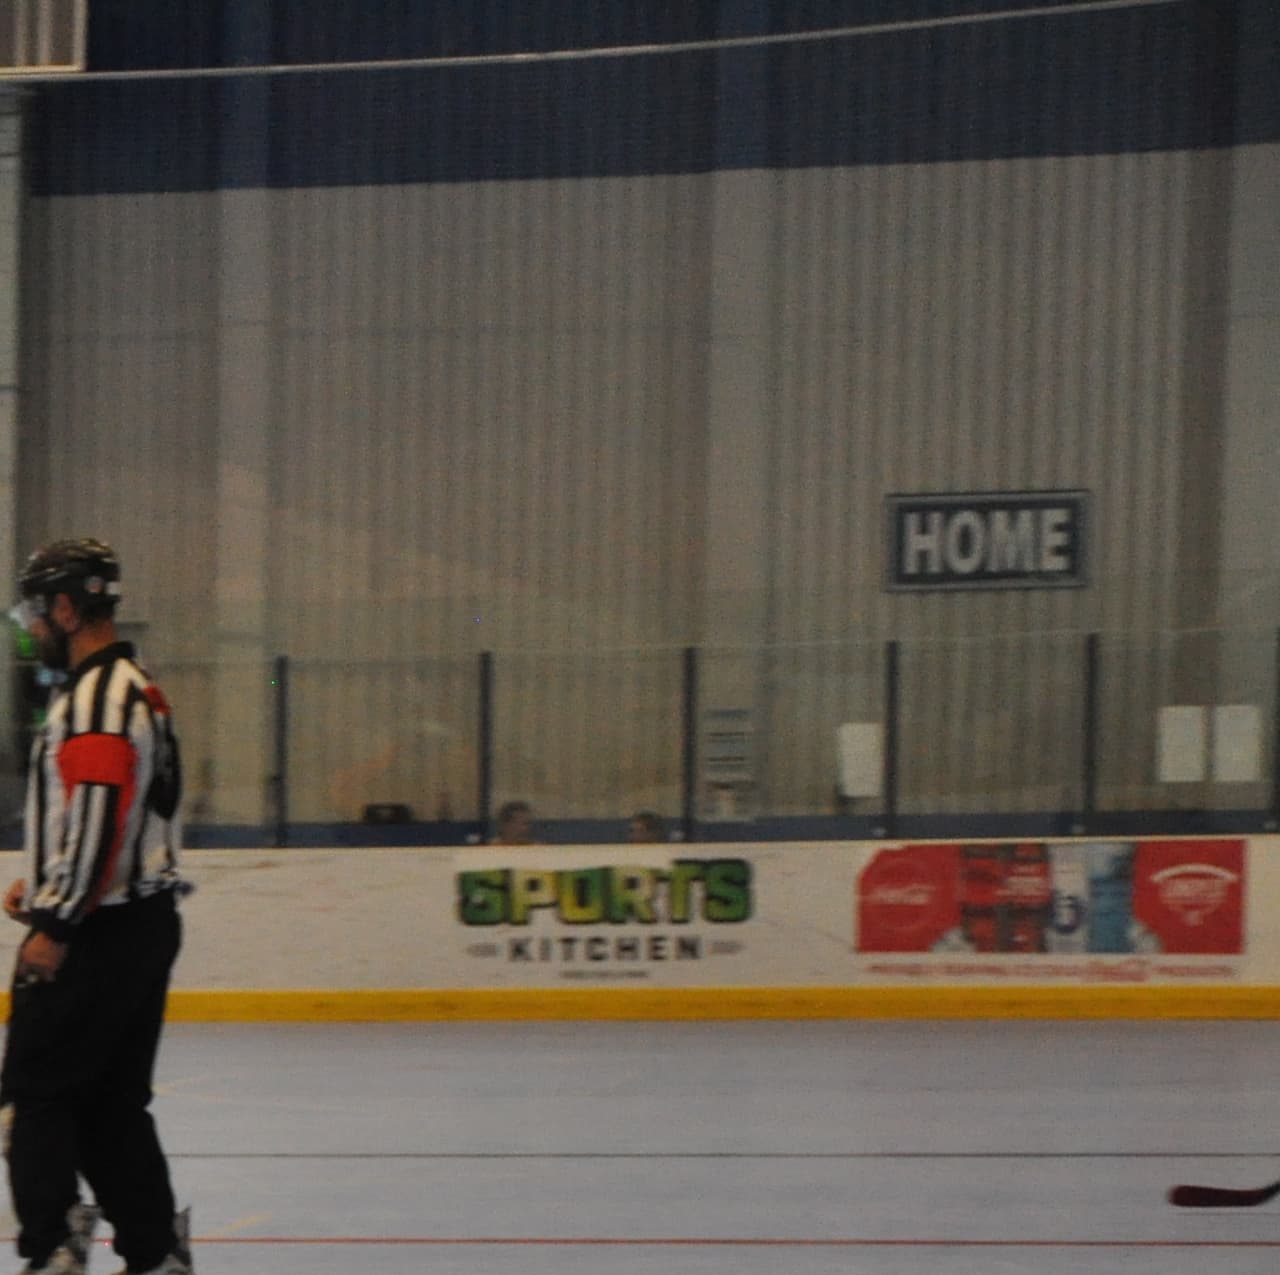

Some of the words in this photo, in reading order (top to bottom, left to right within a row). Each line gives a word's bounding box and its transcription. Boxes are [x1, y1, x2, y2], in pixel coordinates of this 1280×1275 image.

[903, 508, 1071, 574] HOME
[458, 859, 753, 926] SPORTS
[507, 935, 702, 962] KITCHEN
